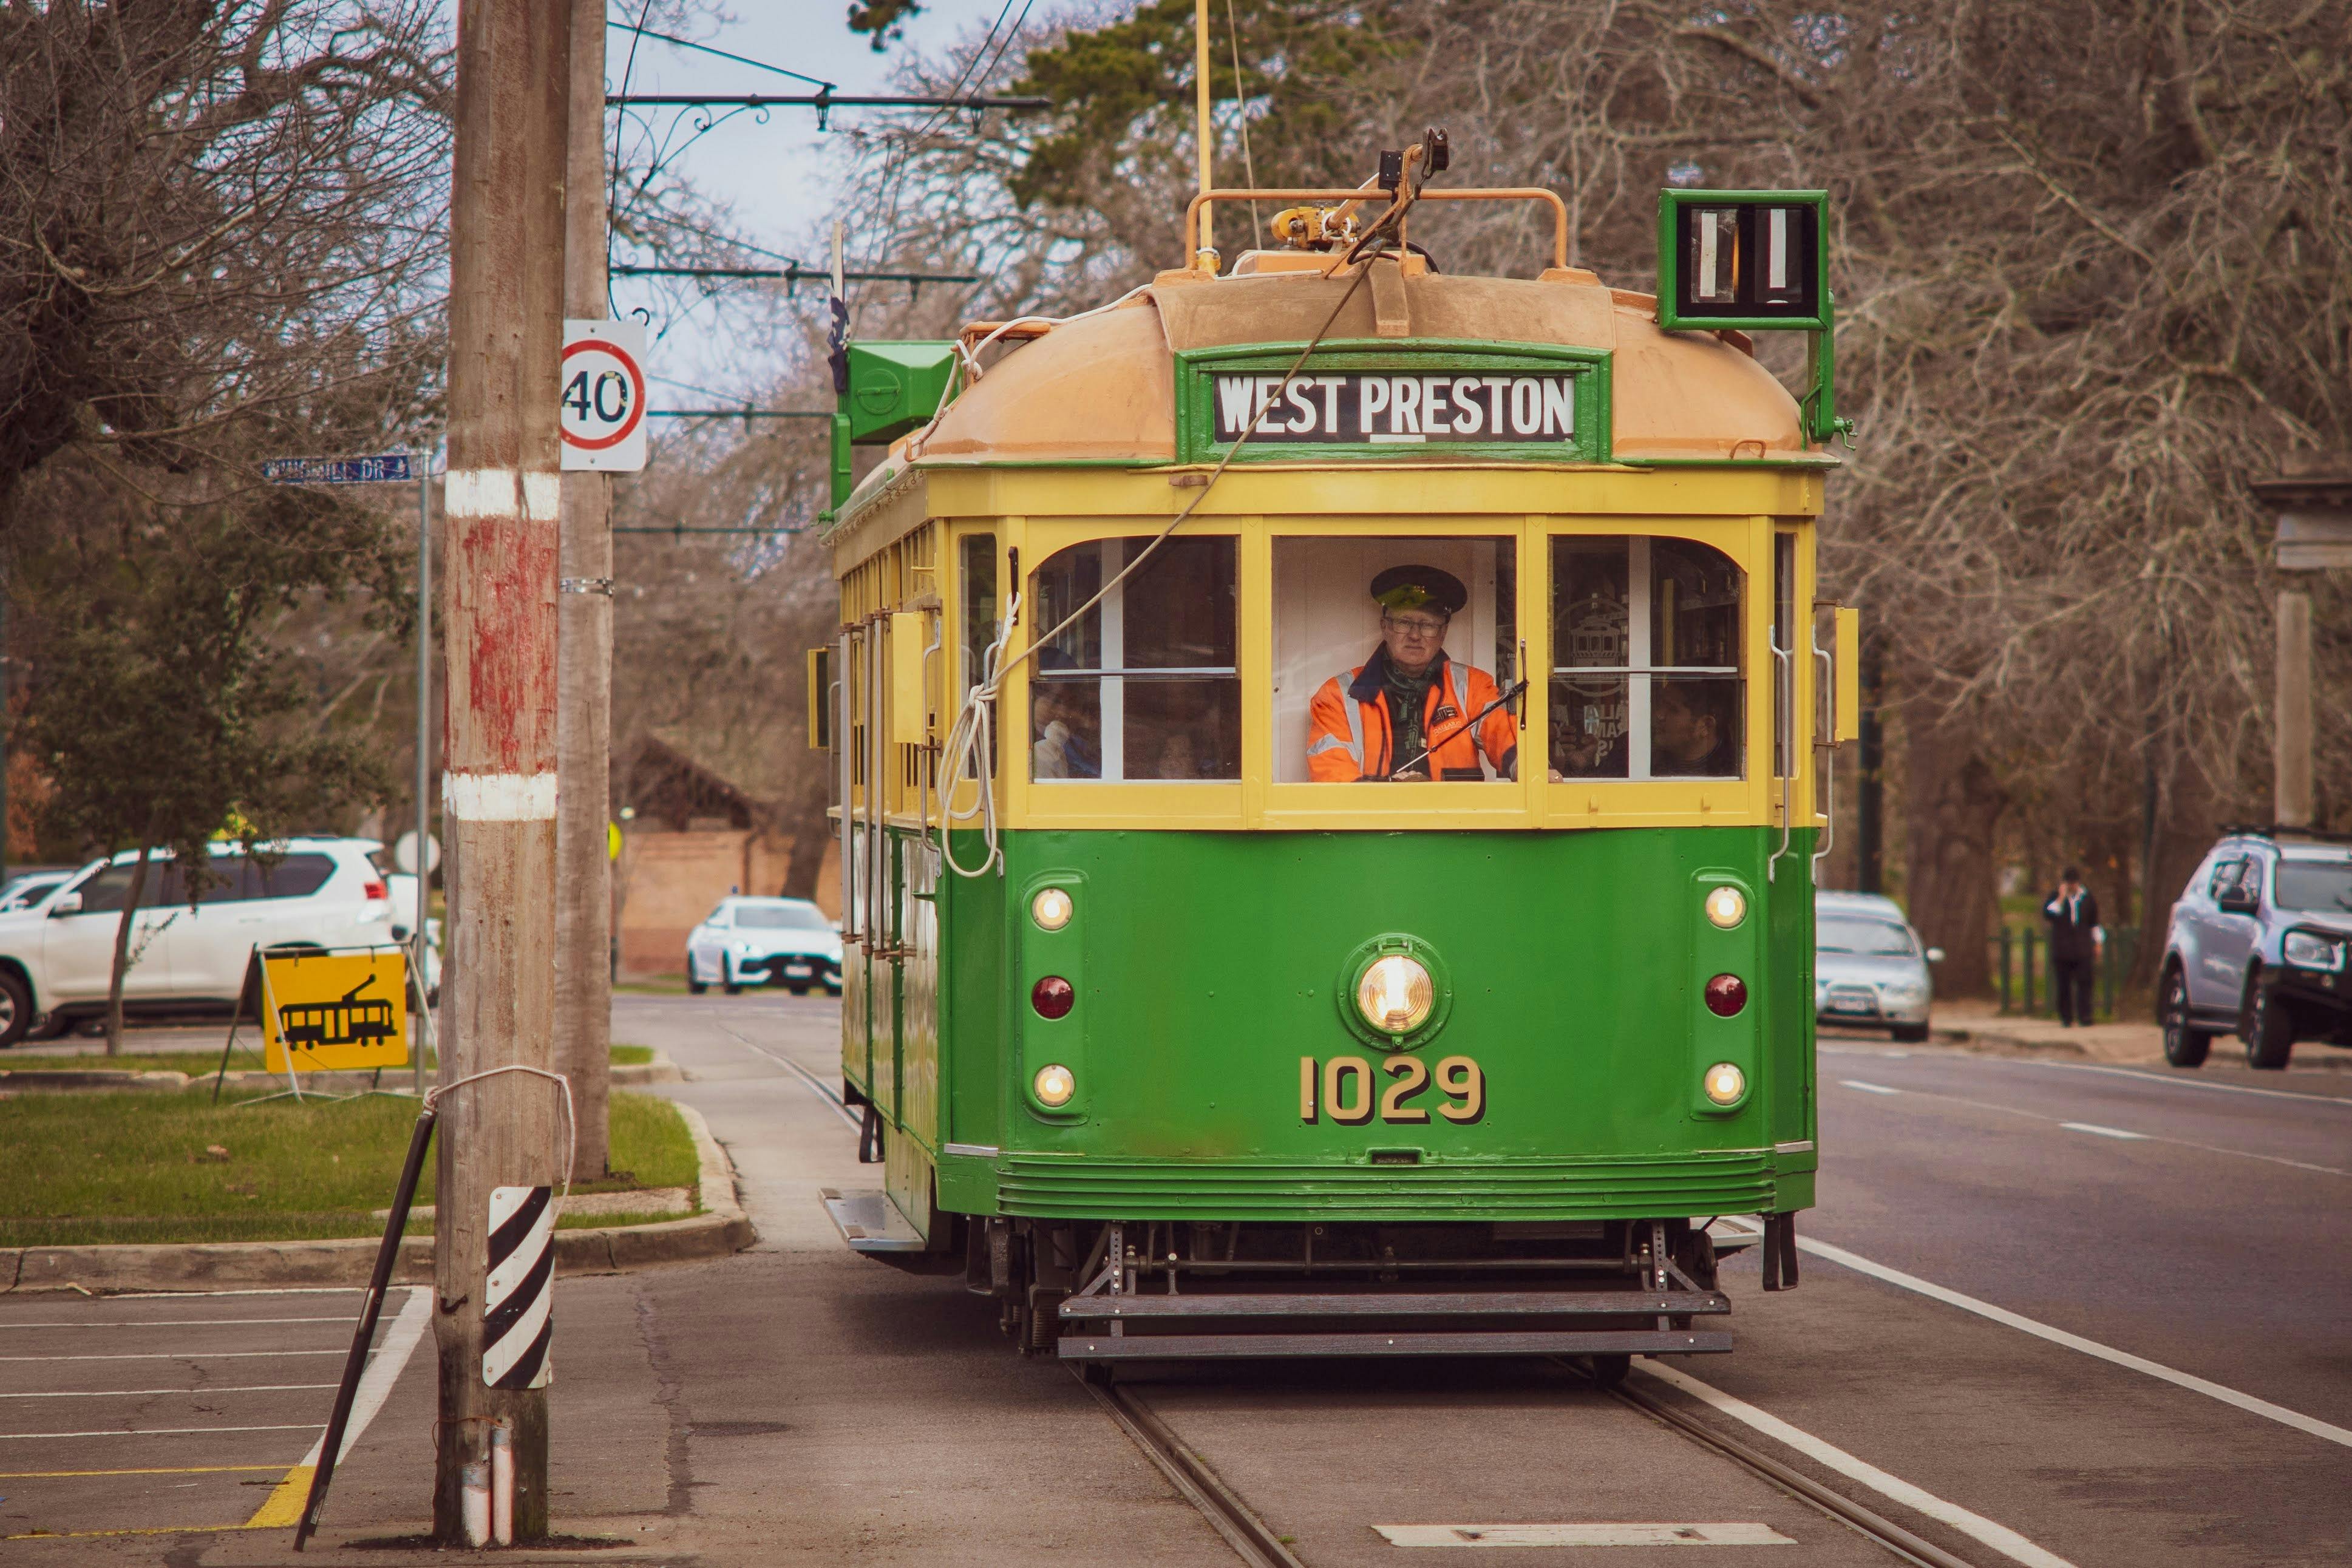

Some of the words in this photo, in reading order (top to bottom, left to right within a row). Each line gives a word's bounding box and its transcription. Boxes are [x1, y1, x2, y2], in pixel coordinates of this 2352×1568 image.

[1700, 209, 1786, 297] 11
[561, 371, 628, 423] 40
[1218, 376, 1347, 434] WEST
[1360, 375, 1575, 434] PRESTON
[362, 460, 384, 479] DR
[1300, 1055, 1486, 1126] 1029
